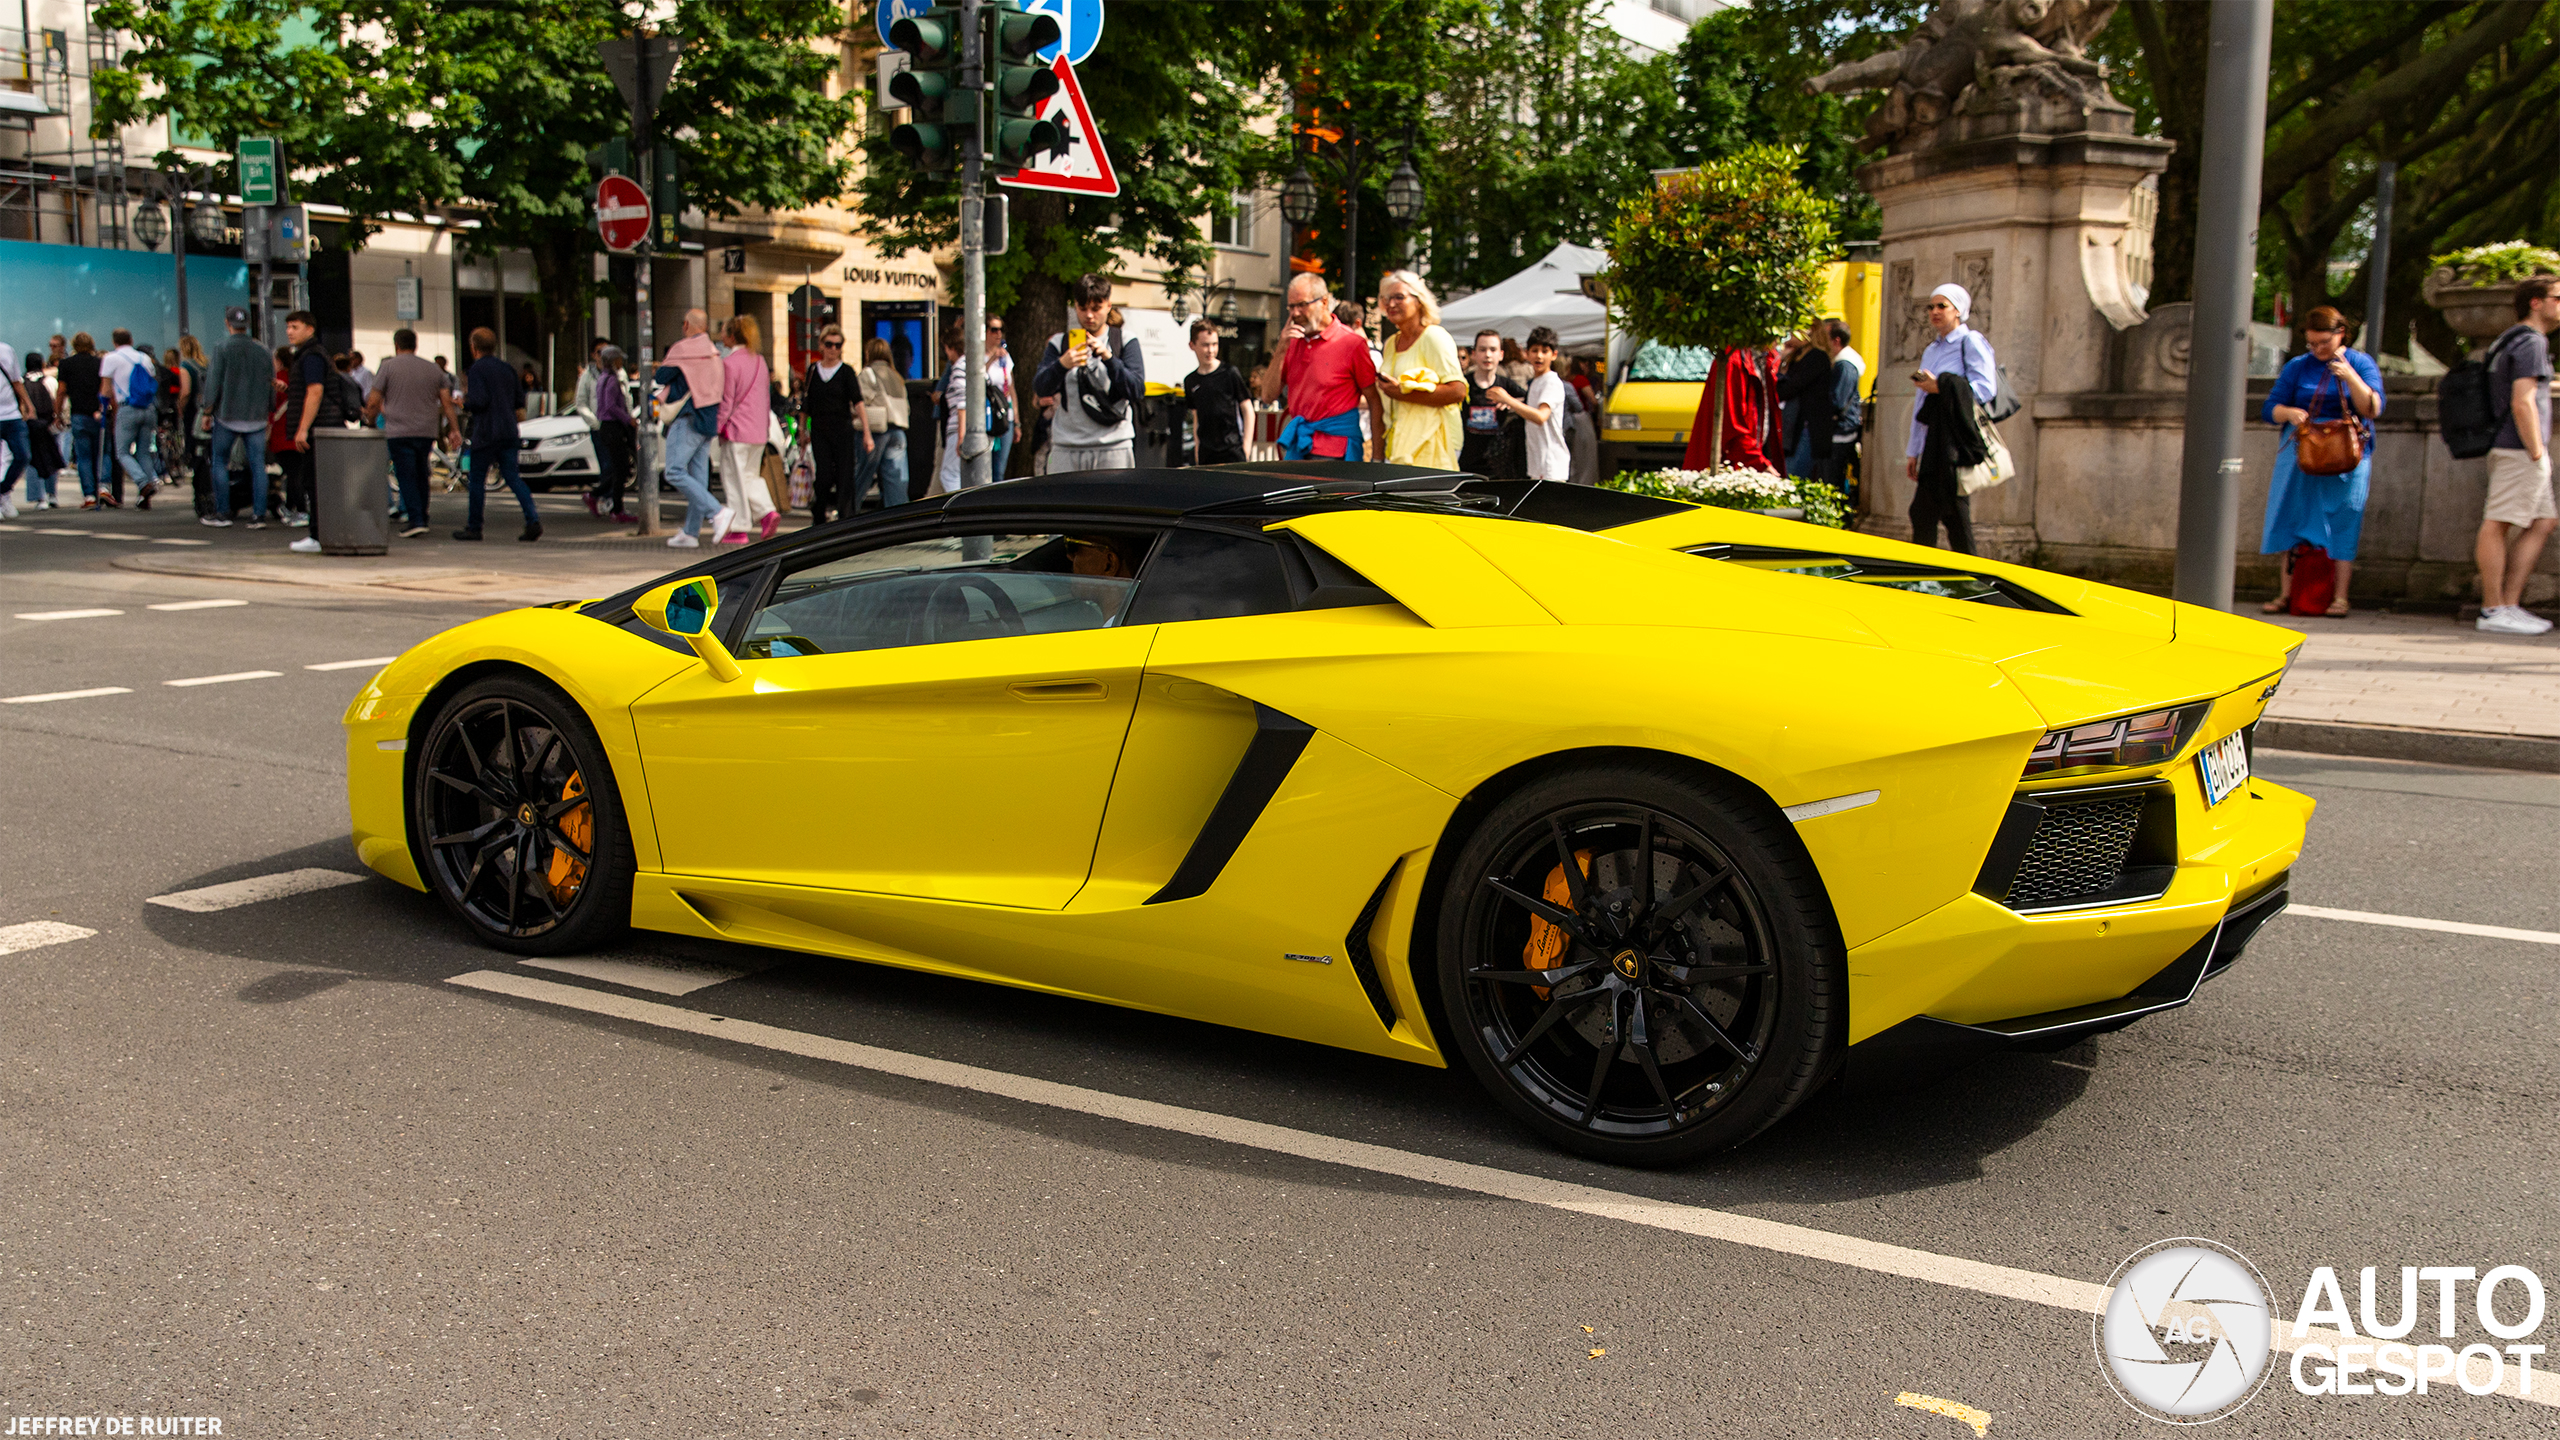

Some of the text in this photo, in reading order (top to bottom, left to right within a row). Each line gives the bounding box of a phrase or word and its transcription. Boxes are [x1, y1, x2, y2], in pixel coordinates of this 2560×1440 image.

[242, 153, 271, 166] Ausgang
[249, 166, 264, 177] Exit
[844, 267, 937, 289] LOUIS VUITTON
